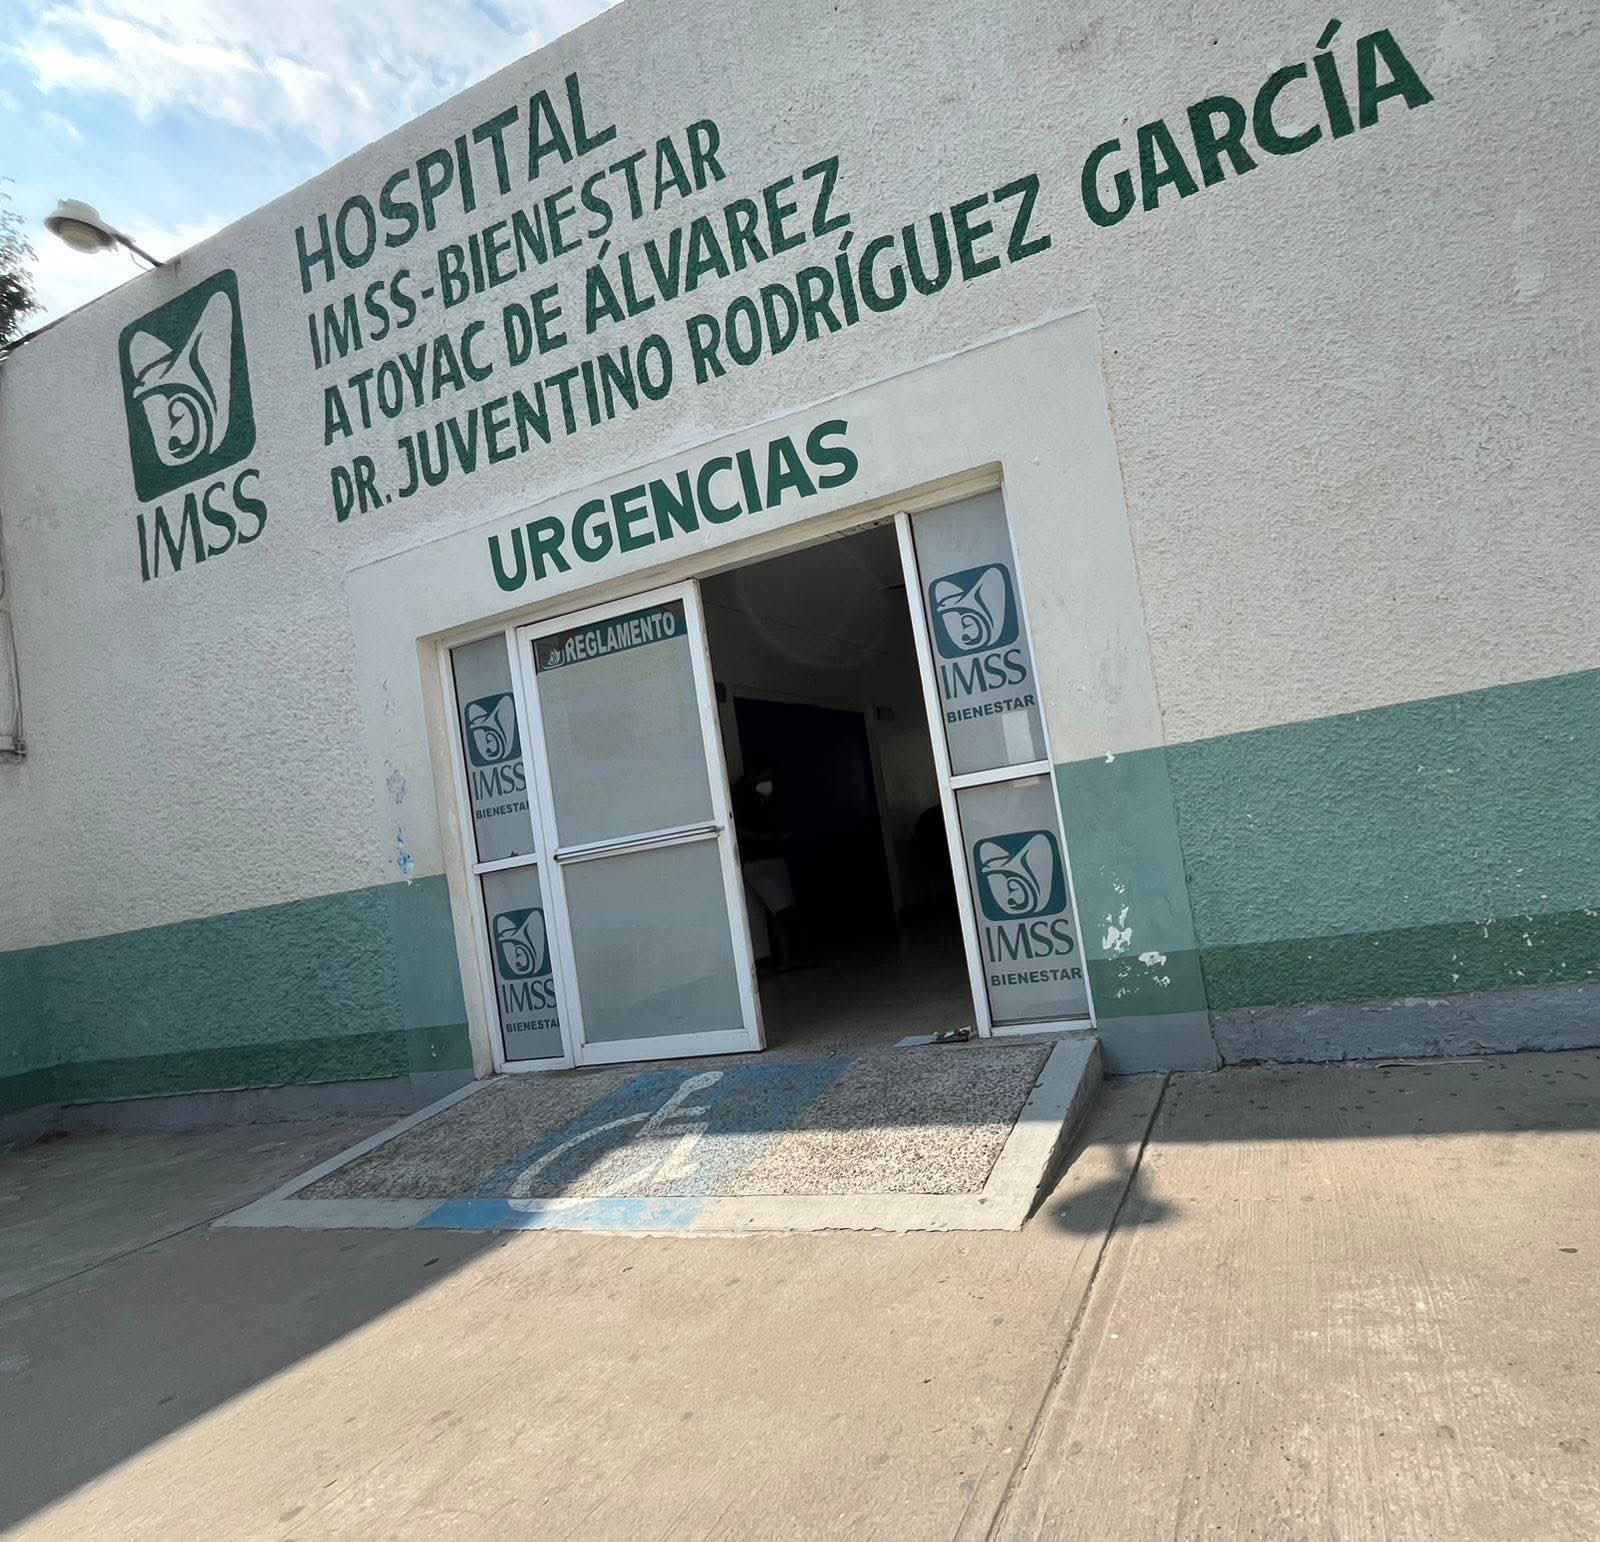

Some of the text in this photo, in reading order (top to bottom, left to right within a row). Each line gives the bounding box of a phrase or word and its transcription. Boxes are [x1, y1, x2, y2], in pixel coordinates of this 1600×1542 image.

[296, 72, 616, 294] HOSPITAL
[308, 118, 725, 370] IMSS-BIENESTAR
[331, 18, 1434, 522] DR. JUVENTINO RODRÍGUEZ GARCÍA
[323, 154, 851, 446] ATOYAC DE ÁLVAREZ
[136, 468, 268, 583] IMSS
[488, 418, 859, 592] URGENCIAS
[564, 611, 676, 662] REGLAMENTO
[941, 648, 1028, 700] IMSS
[946, 694, 1036, 724] BIENESTAR
[472, 761, 527, 801] IMSS
[475, 800, 530, 820] BIENESTA
[985, 918, 1075, 962] IMSS
[502, 978, 557, 1014] IMSS
[990, 966, 1083, 987] BIENESTAR
[506, 1017, 560, 1033] BIENESTA
